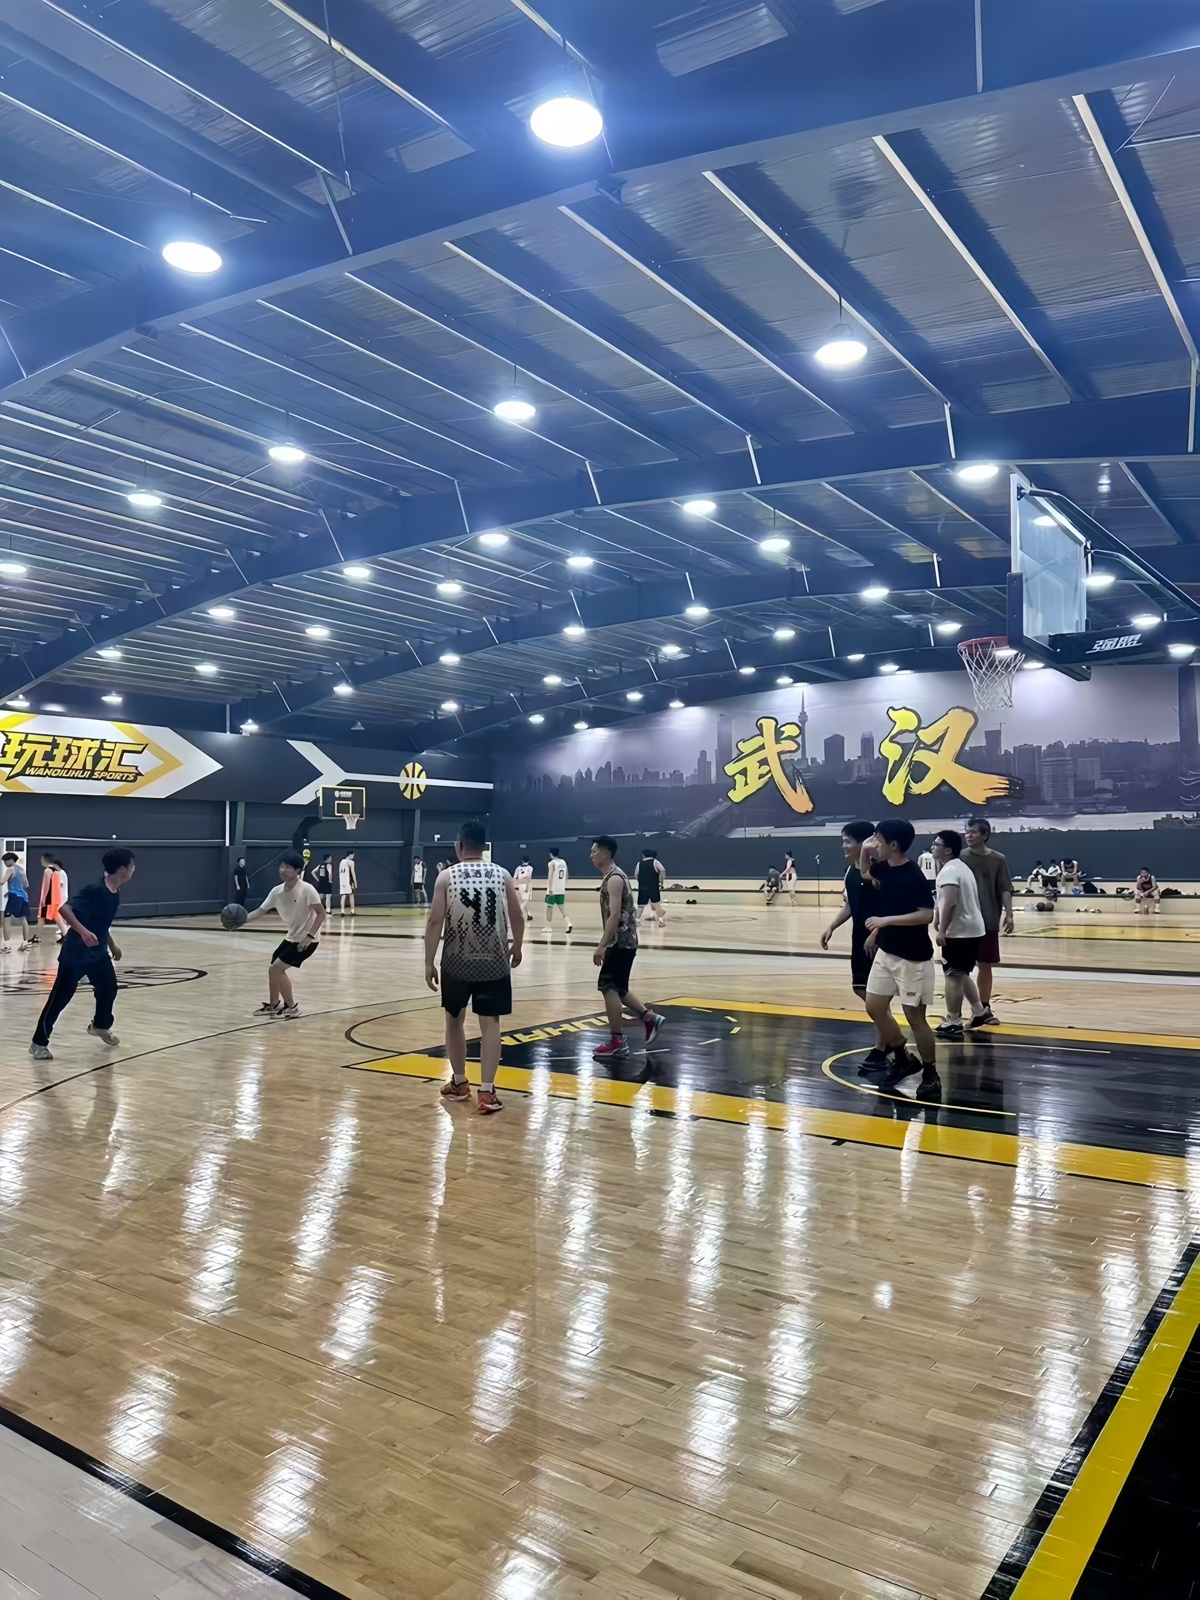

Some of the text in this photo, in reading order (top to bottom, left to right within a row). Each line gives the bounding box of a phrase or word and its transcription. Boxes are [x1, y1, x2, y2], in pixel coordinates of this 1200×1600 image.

[0, 730, 149, 781] 玩球汇
[92, 771, 135, 780] SPORTS
